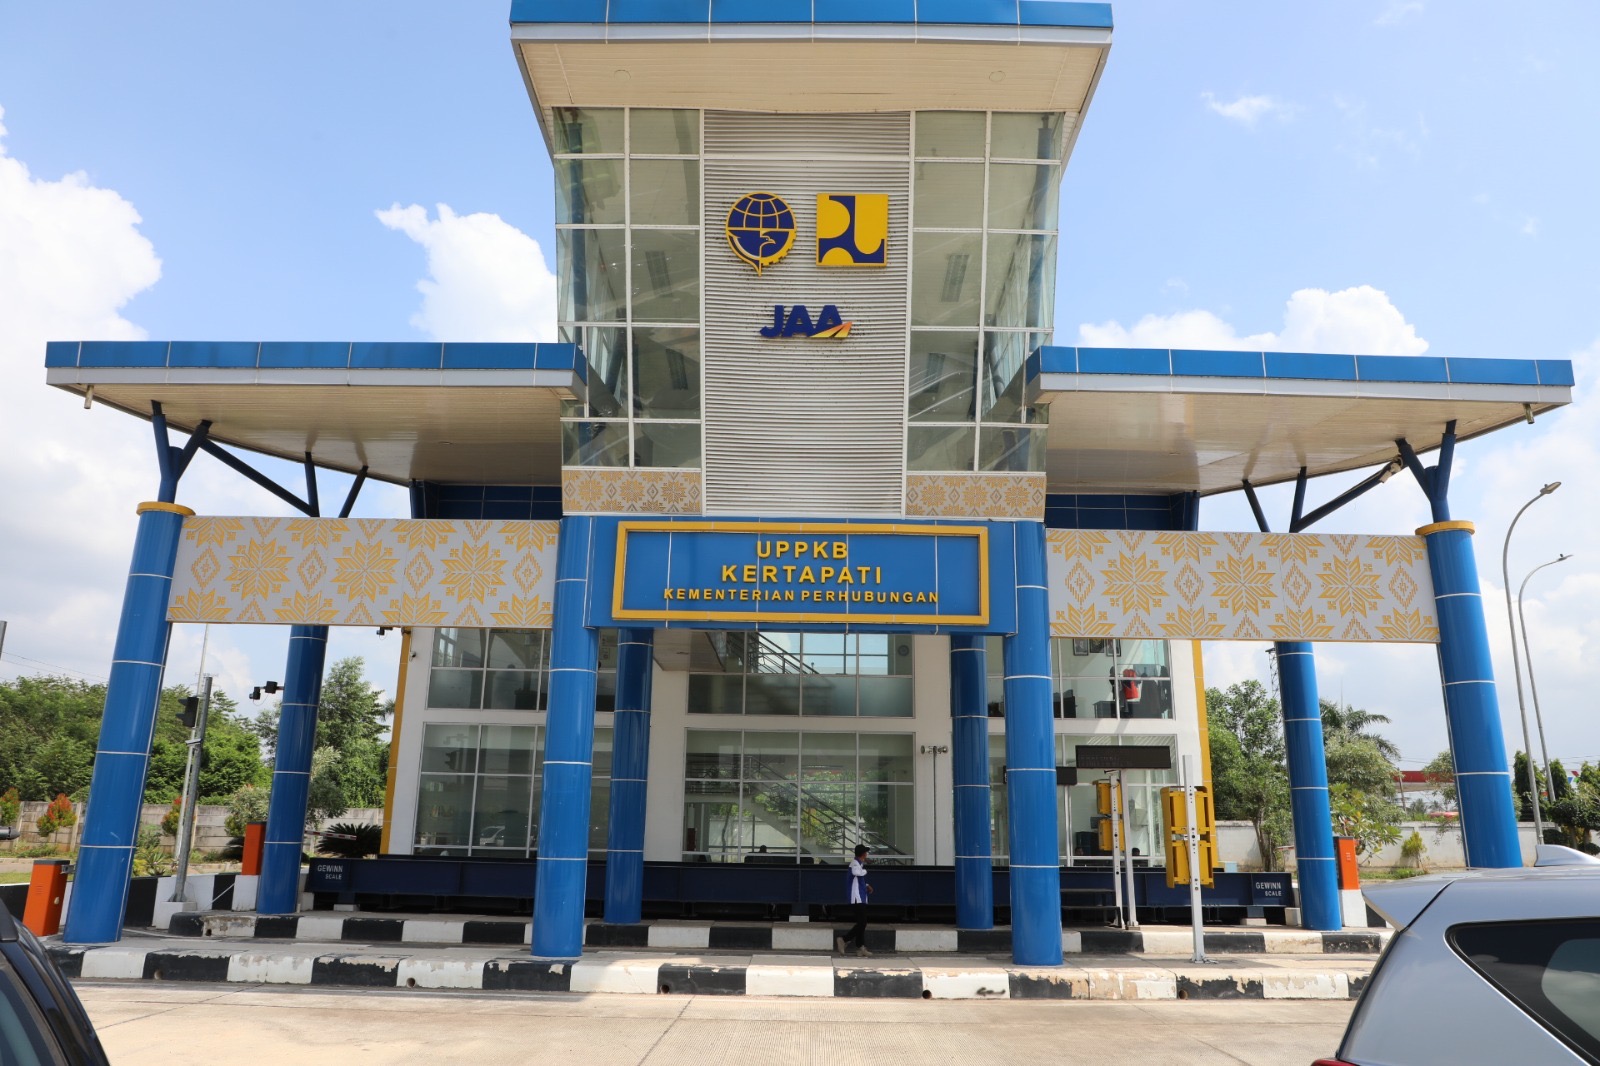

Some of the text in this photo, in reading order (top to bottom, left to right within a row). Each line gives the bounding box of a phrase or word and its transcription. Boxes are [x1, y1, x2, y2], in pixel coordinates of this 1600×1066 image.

[759, 304, 853, 338] JAA
[756, 541, 848, 559] UPPKB
[721, 565, 882, 584] KERTAPATI
[663, 588, 939, 603] KEMENTERIAN PERHUBUNGAN
[317, 865, 344, 873] GEWINN
